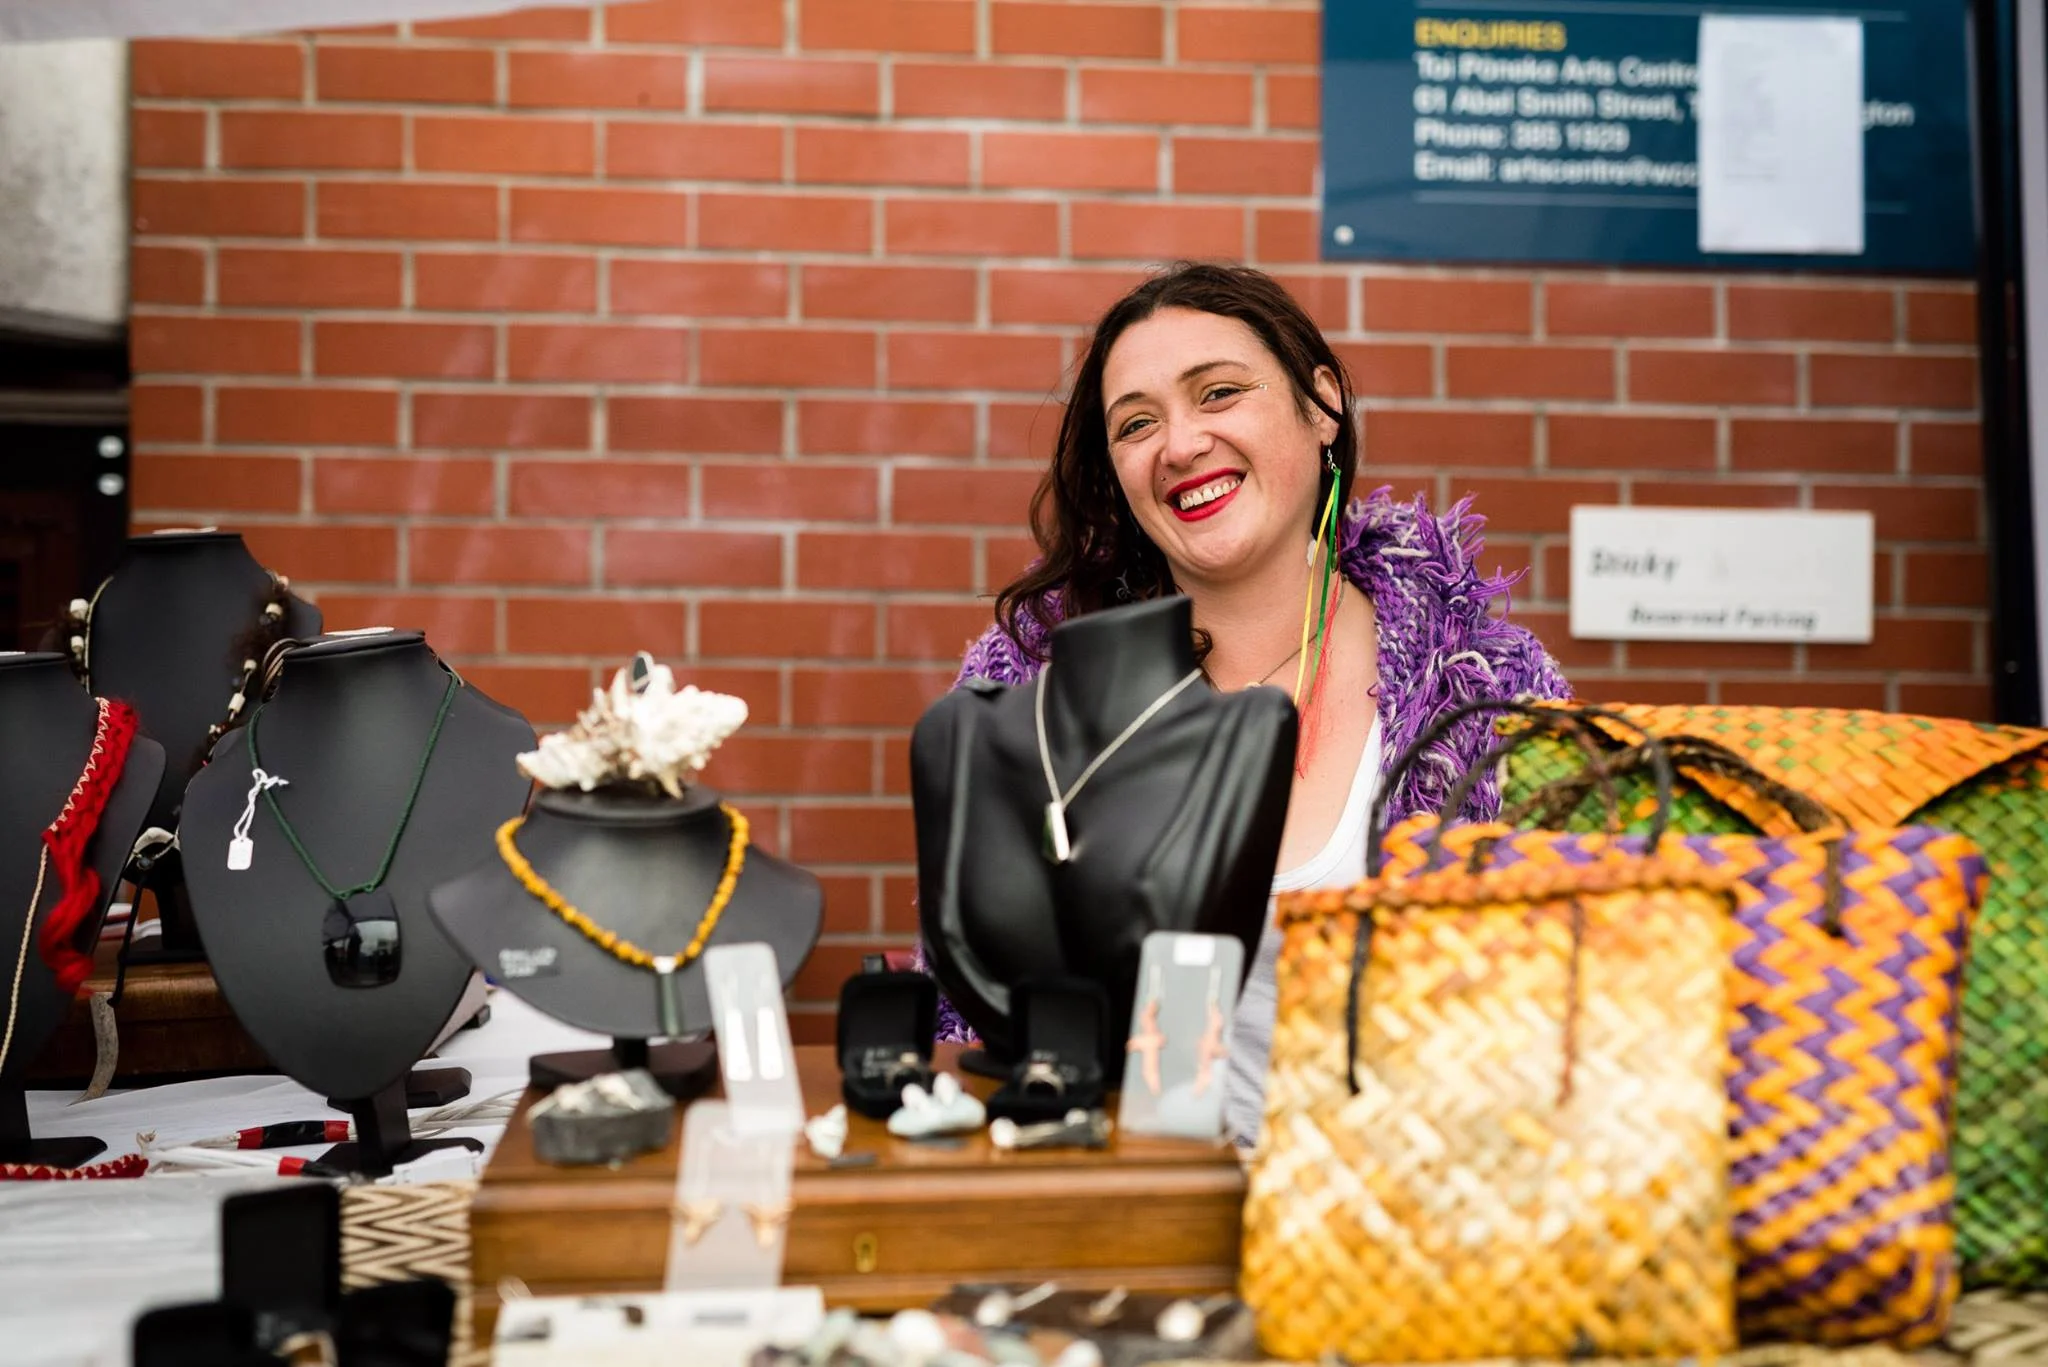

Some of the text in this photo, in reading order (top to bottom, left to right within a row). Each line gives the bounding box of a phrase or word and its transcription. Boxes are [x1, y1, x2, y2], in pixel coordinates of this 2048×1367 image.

[1415, 19, 1566, 50] ENQUIRIES
[1413, 52, 1455, 81] Toi
[1561, 56, 1617, 86] Arts
[1413, 84, 1447, 114] 61
[1452, 86, 1515, 116] Abel
[1517, 87, 1595, 118] Smith
[1414, 117, 1508, 149] Phone:
[1414, 151, 1496, 182] Email:
